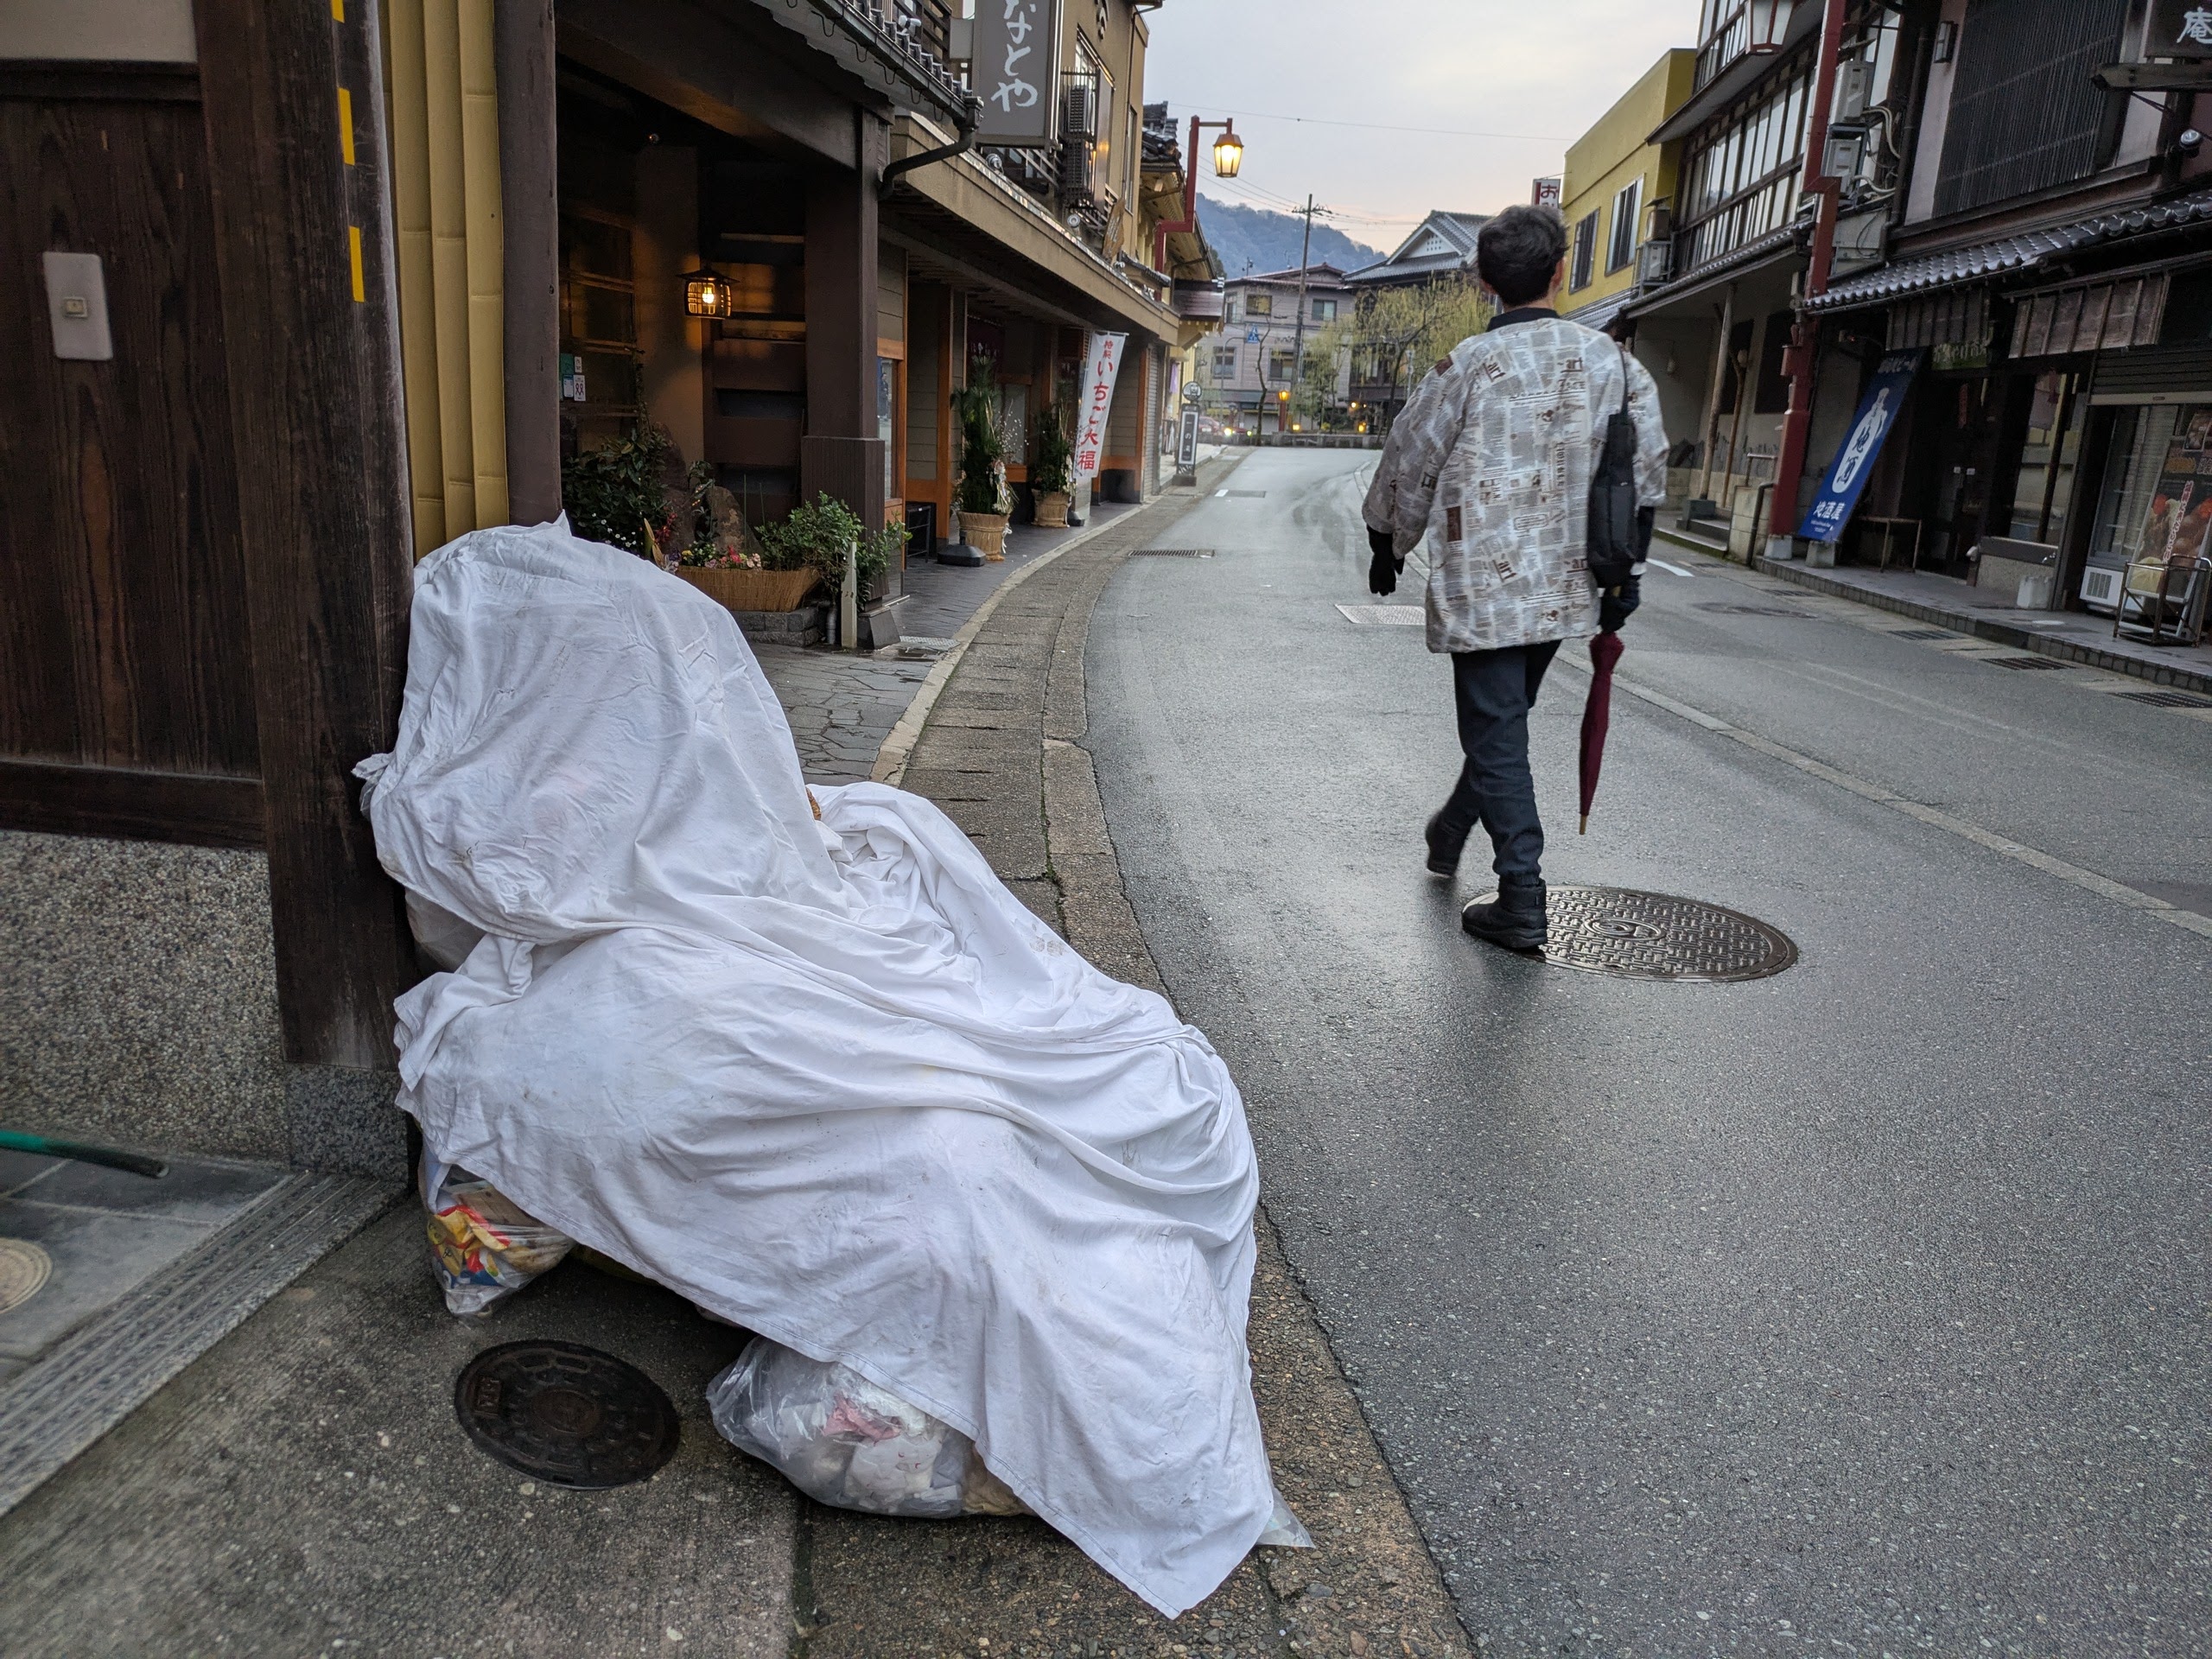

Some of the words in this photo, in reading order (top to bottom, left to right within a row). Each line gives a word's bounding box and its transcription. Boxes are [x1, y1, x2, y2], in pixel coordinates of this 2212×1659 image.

[991, 0, 1039, 112] なとや
[1077, 361, 1113, 470] いちご大福
